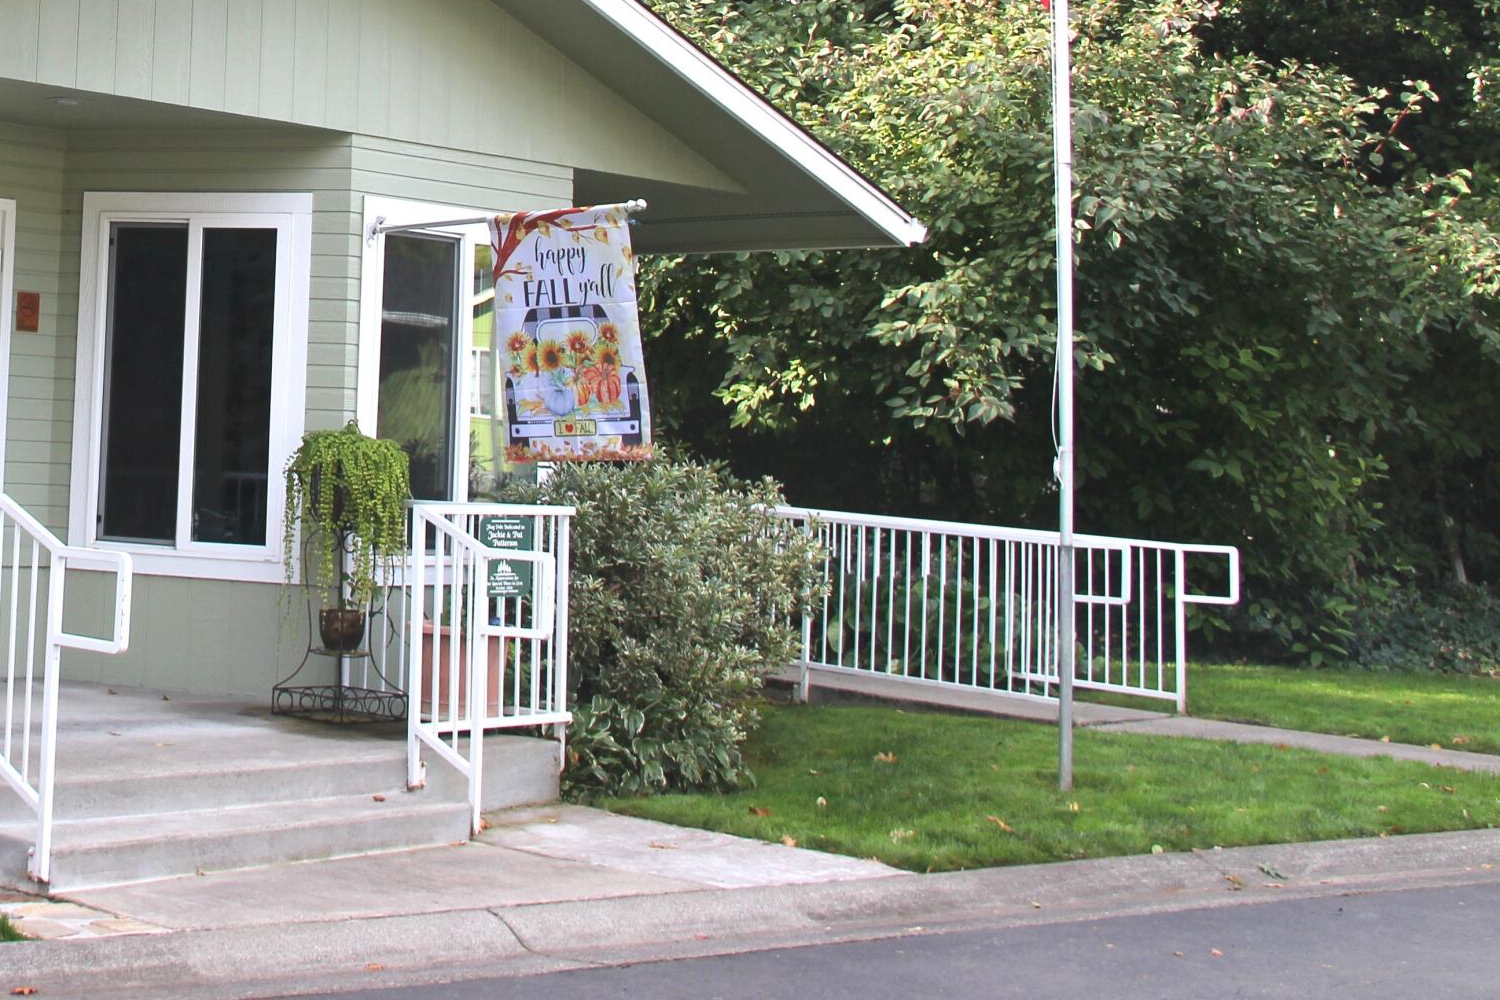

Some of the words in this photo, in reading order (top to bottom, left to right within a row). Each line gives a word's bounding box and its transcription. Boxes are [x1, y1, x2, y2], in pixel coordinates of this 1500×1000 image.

[535, 236, 586, 276] happy
[523, 278, 577, 307] FALL
[558, 422, 563, 434] I
